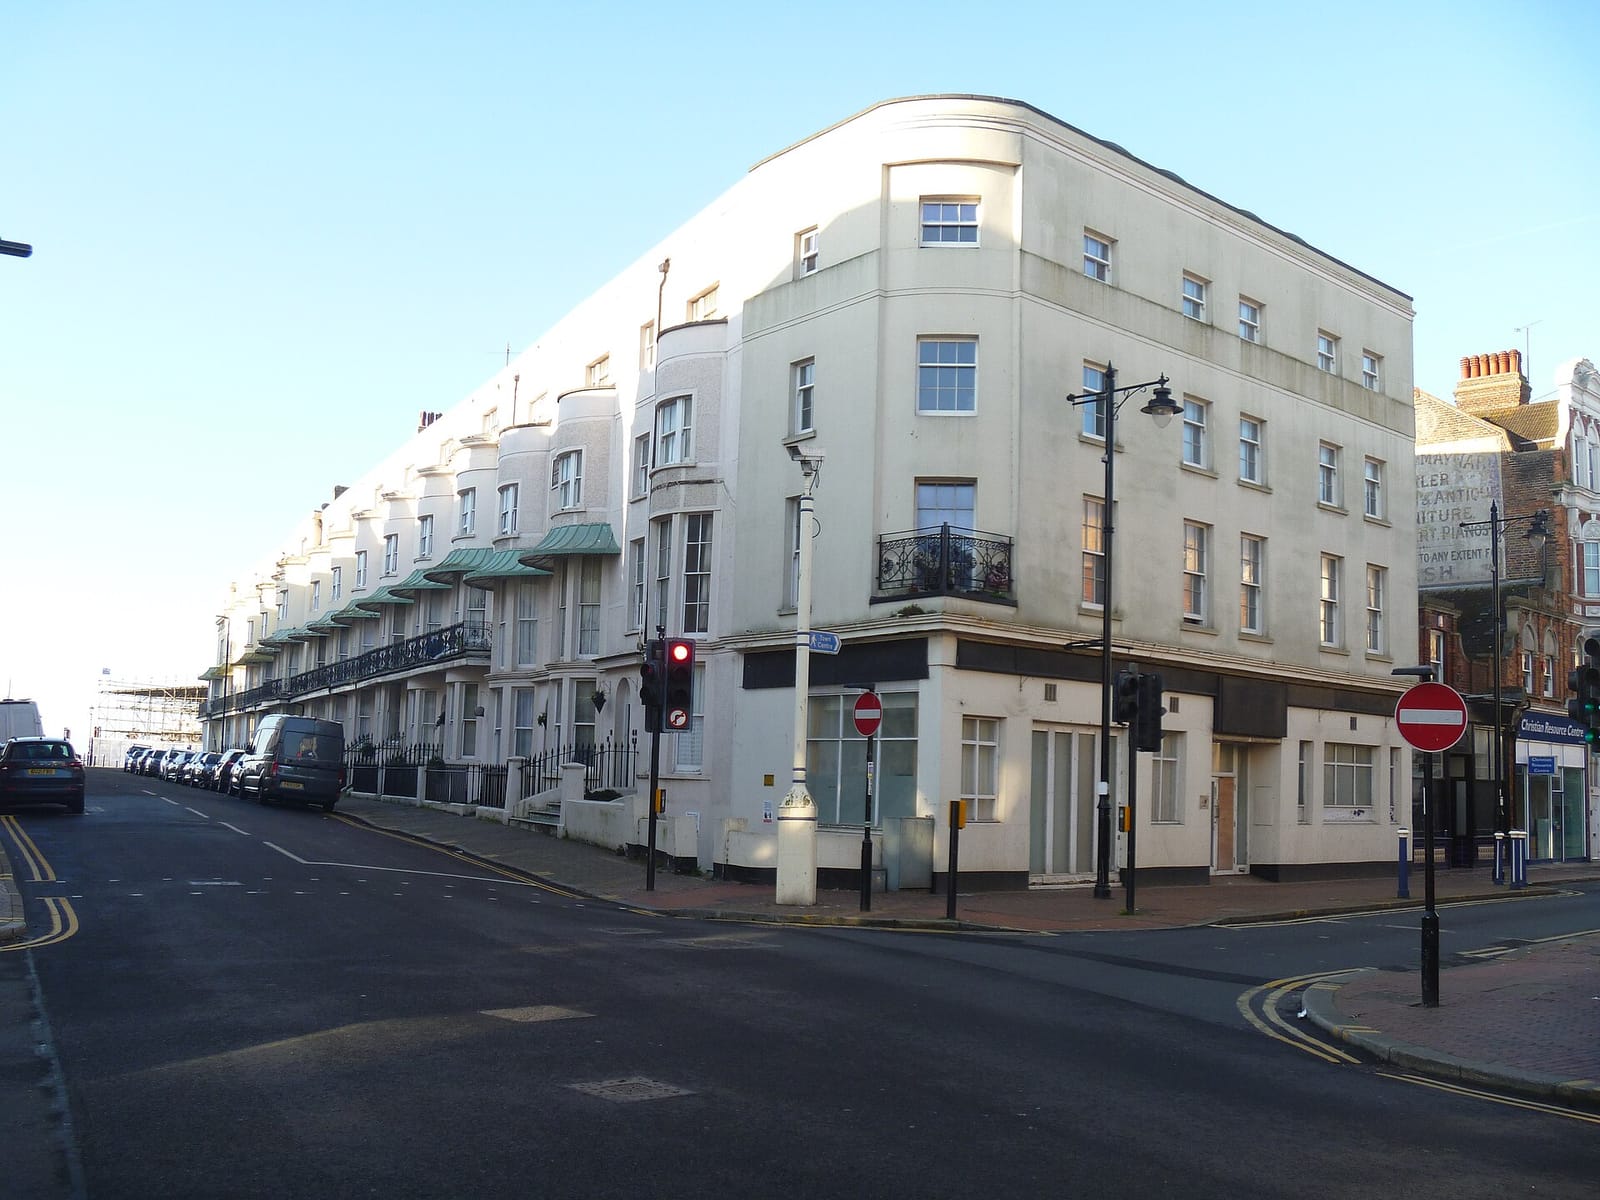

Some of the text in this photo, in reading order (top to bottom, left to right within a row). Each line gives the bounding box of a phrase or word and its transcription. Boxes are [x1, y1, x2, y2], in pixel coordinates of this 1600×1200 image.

[1431, 551, 1449, 562] ANY
[1451, 549, 1482, 561] EXTENT
[1521, 718, 1584, 738] Christian Resource Centre
